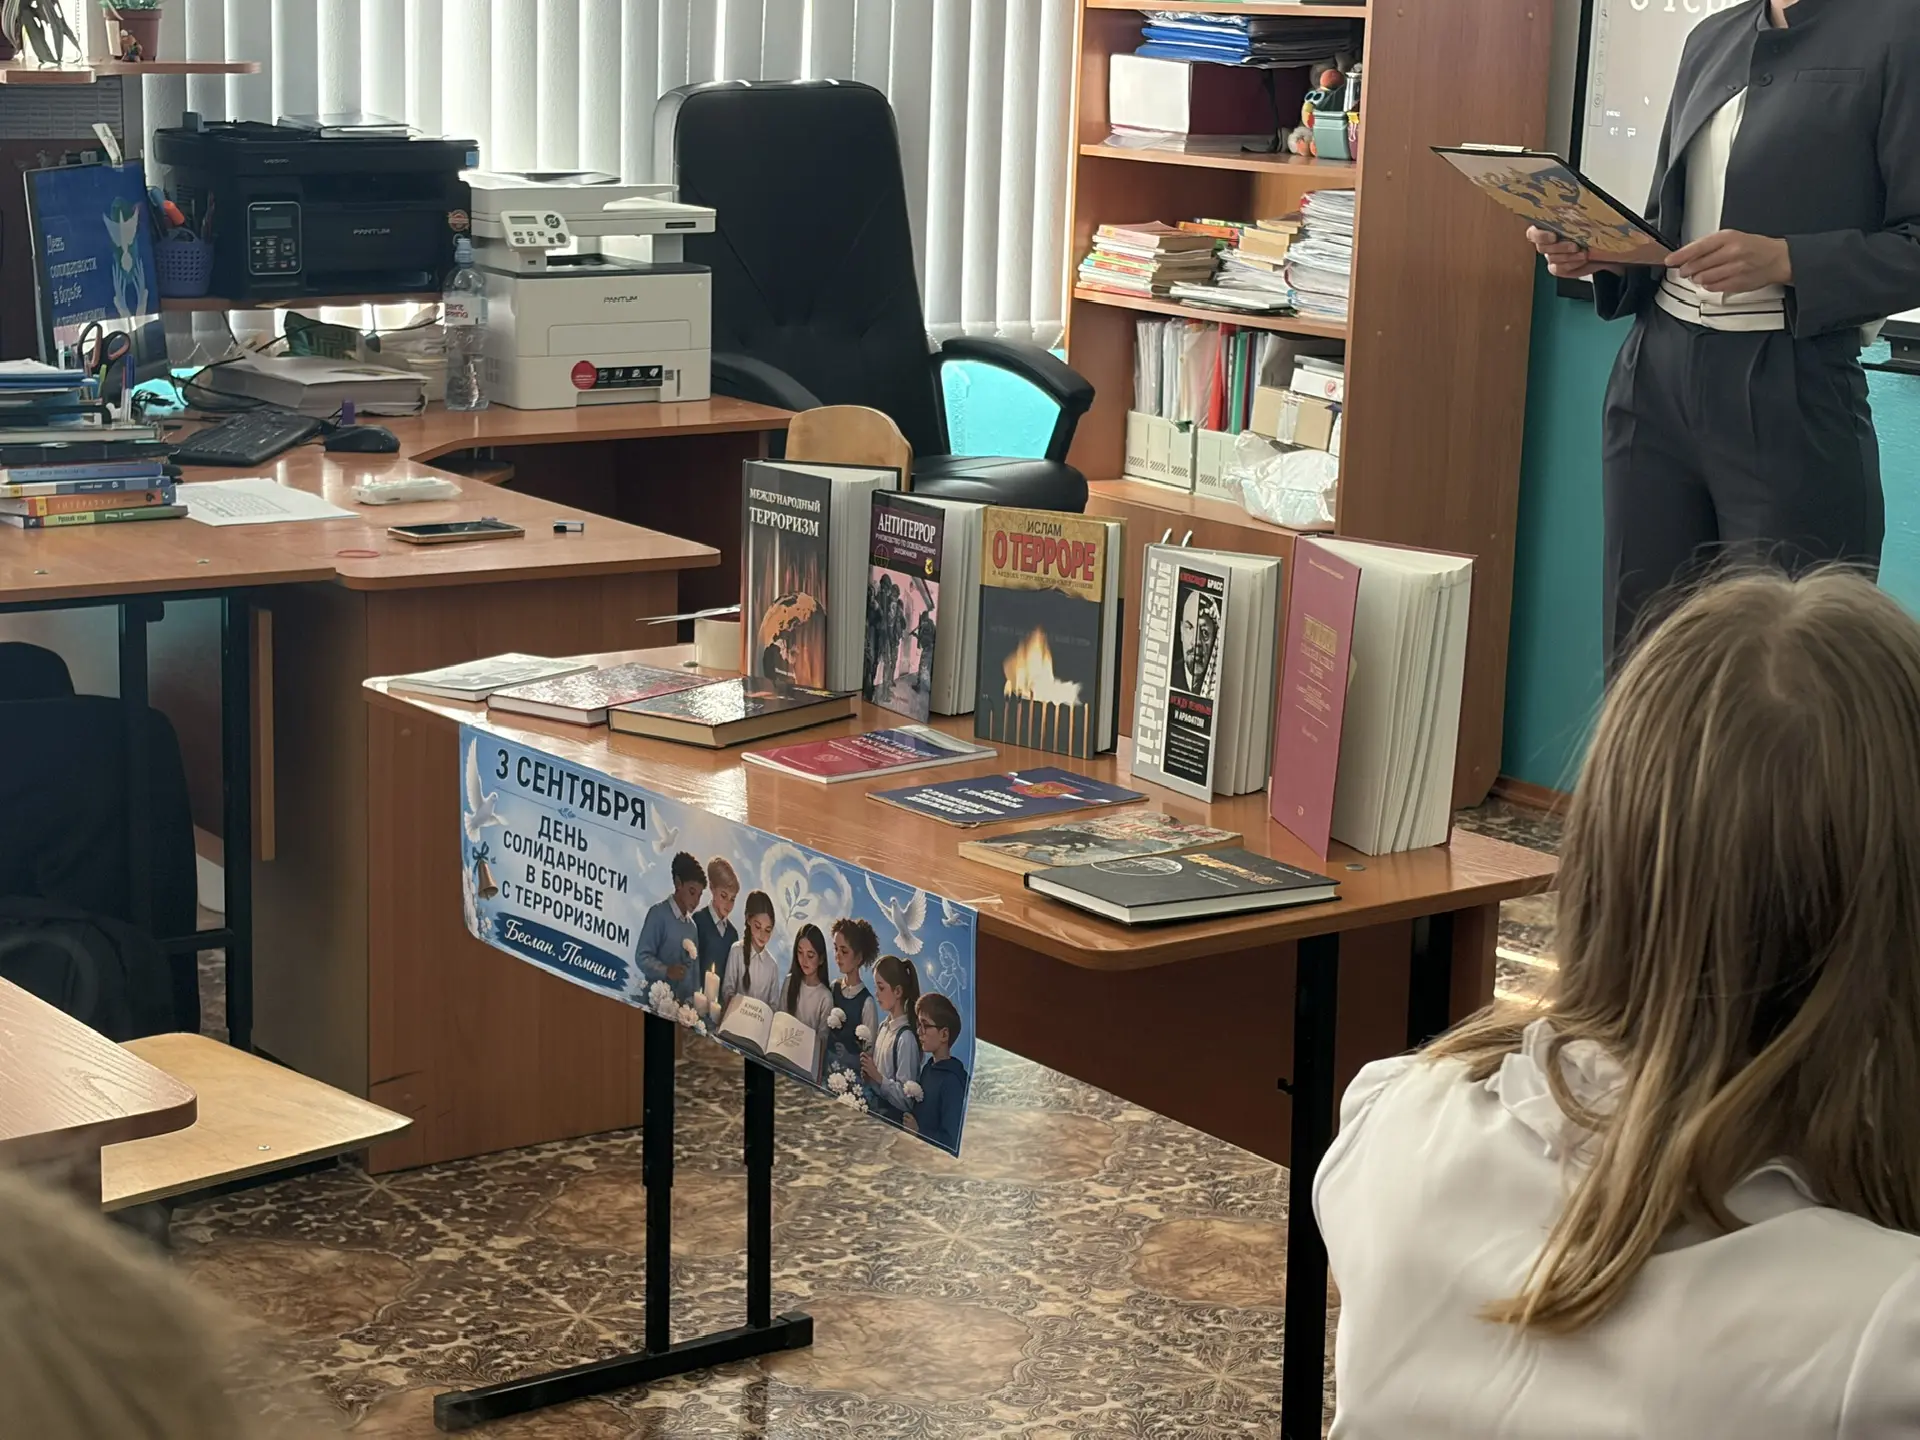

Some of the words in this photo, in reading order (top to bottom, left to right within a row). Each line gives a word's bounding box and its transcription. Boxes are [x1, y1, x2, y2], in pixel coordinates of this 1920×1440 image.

[603, 296, 638, 304] PANTUM
[749, 487, 821, 514] МЕЖДУНАРОДНЫЙ
[749, 506, 820, 538] ТЕРРОРИЗМ
[877, 512, 937, 544] АНТИТЕРРОР
[1026, 520, 1062, 537] ИСЛАМ
[992, 530, 1008, 570] О
[1009, 532, 1096, 582] ТЕРРОРЕ
[1136, 560, 1173, 767] ТЕРРОРИЗМ
[495, 748, 509, 780] 3
[516, 756, 647, 831] СЕНТЯБРЯ
[538, 815, 588, 852] ДЕНЬ
[503, 830, 629, 894] СОЛИДАРНОСТИ
[526, 864, 536, 884] В
[541, 870, 604, 912] БОРЬБЕ
[501, 881, 511, 899] С
[515, 884, 631, 948] ТЕРРОРИЗМОМ
[503, 918, 556, 957] Беслан.
[558, 940, 618, 982] Помним
